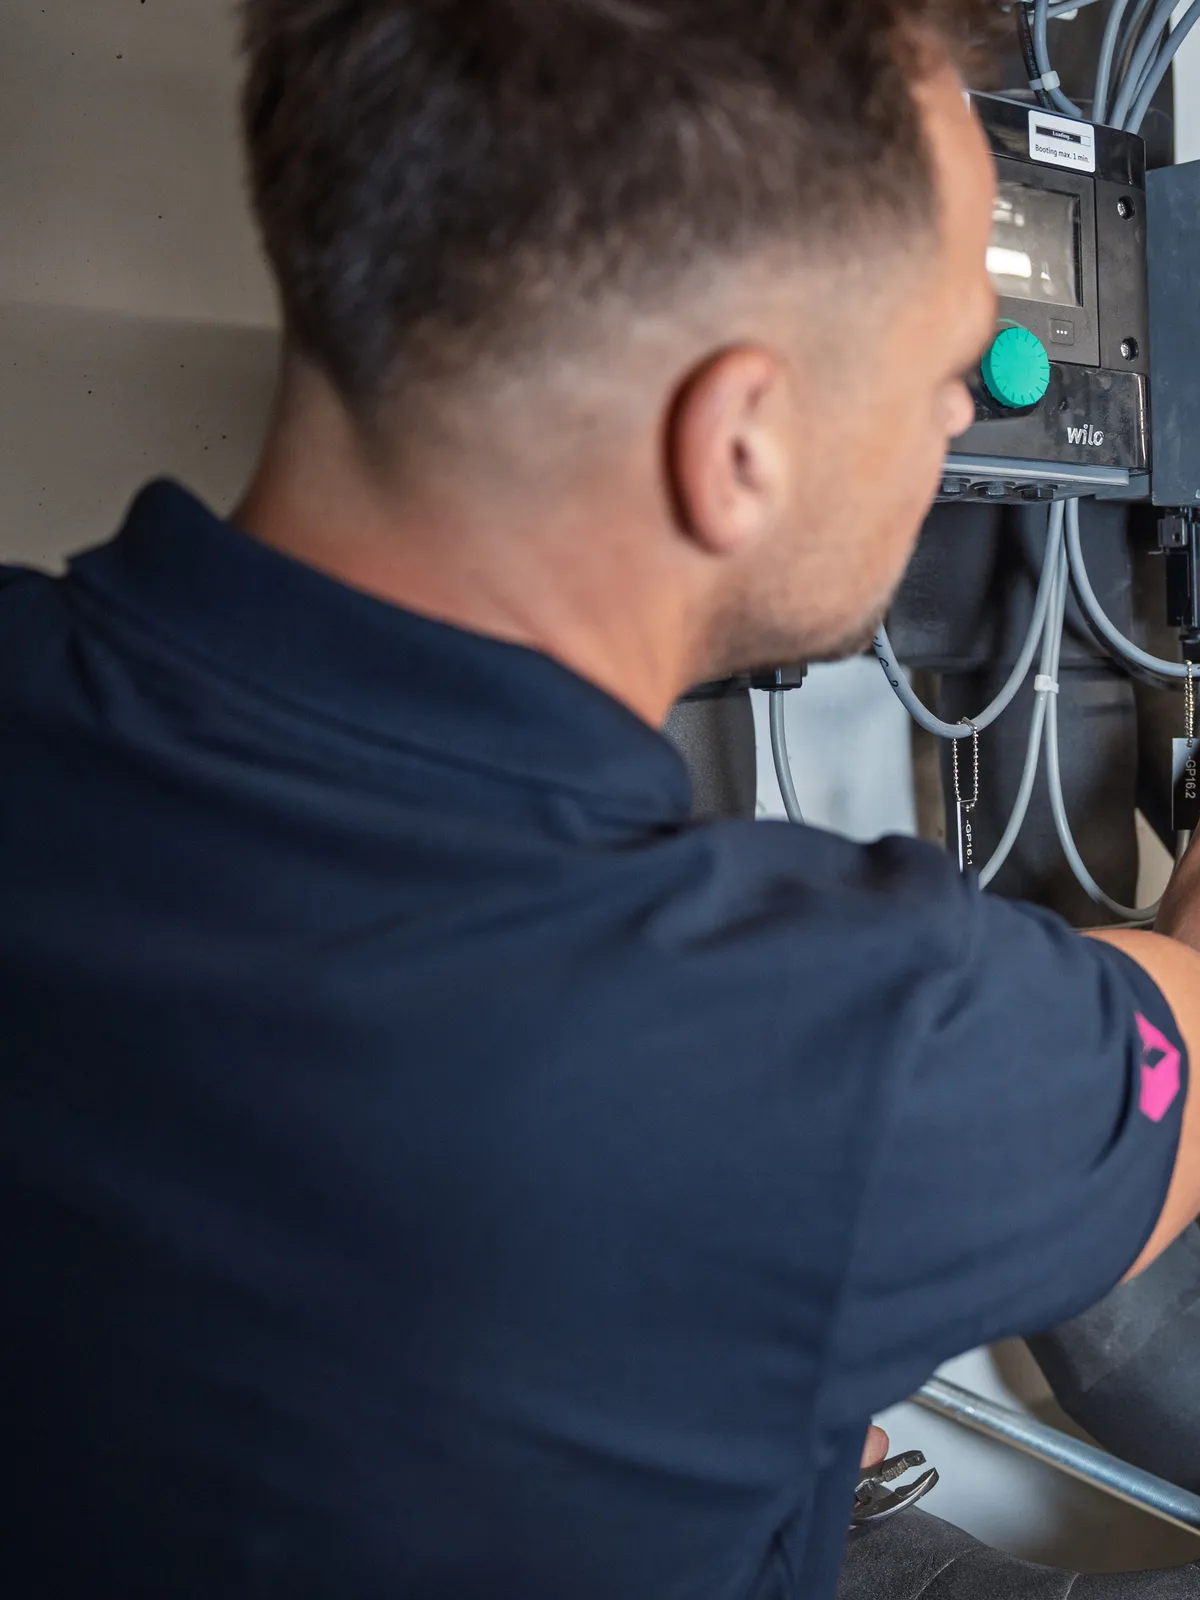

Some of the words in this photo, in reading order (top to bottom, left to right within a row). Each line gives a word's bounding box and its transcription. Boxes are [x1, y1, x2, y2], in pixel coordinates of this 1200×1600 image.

[1035, 144, 1058, 158] Booting
[1067, 423, 1105, 446] wilo
[1185, 755, 1197, 799] -GP16.2
[965, 819, 973, 865] -GP16.1
